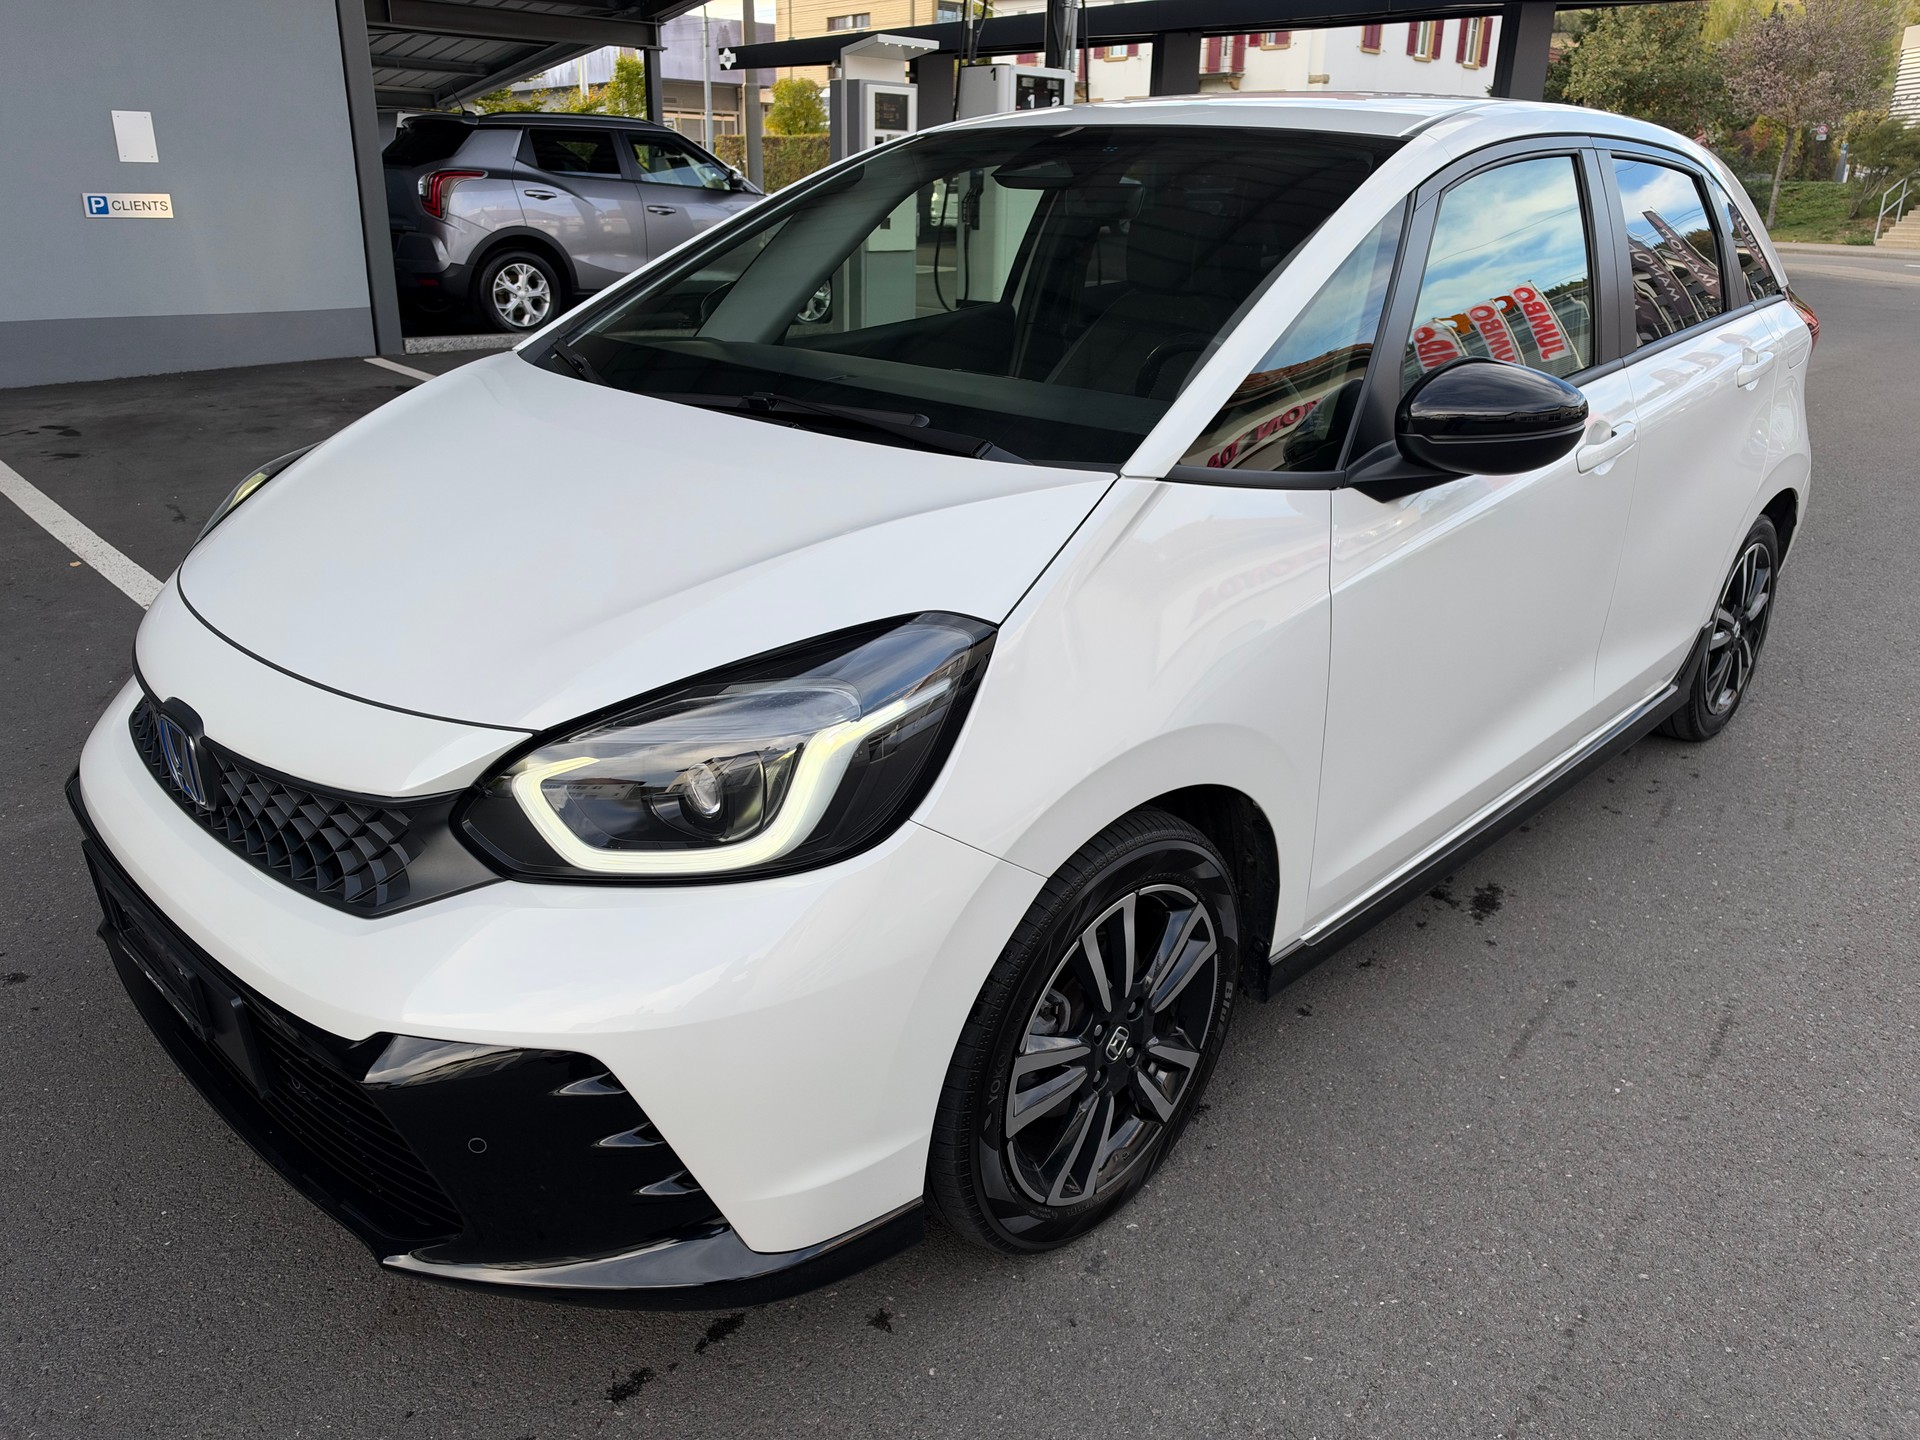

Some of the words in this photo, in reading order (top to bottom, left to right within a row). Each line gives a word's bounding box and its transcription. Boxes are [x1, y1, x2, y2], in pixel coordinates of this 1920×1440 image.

[990, 67, 997, 81] 1
[1027, 94, 1035, 109] 1
[1051, 96, 1060, 107] 2
[111, 200, 168, 211] CLIENTS
